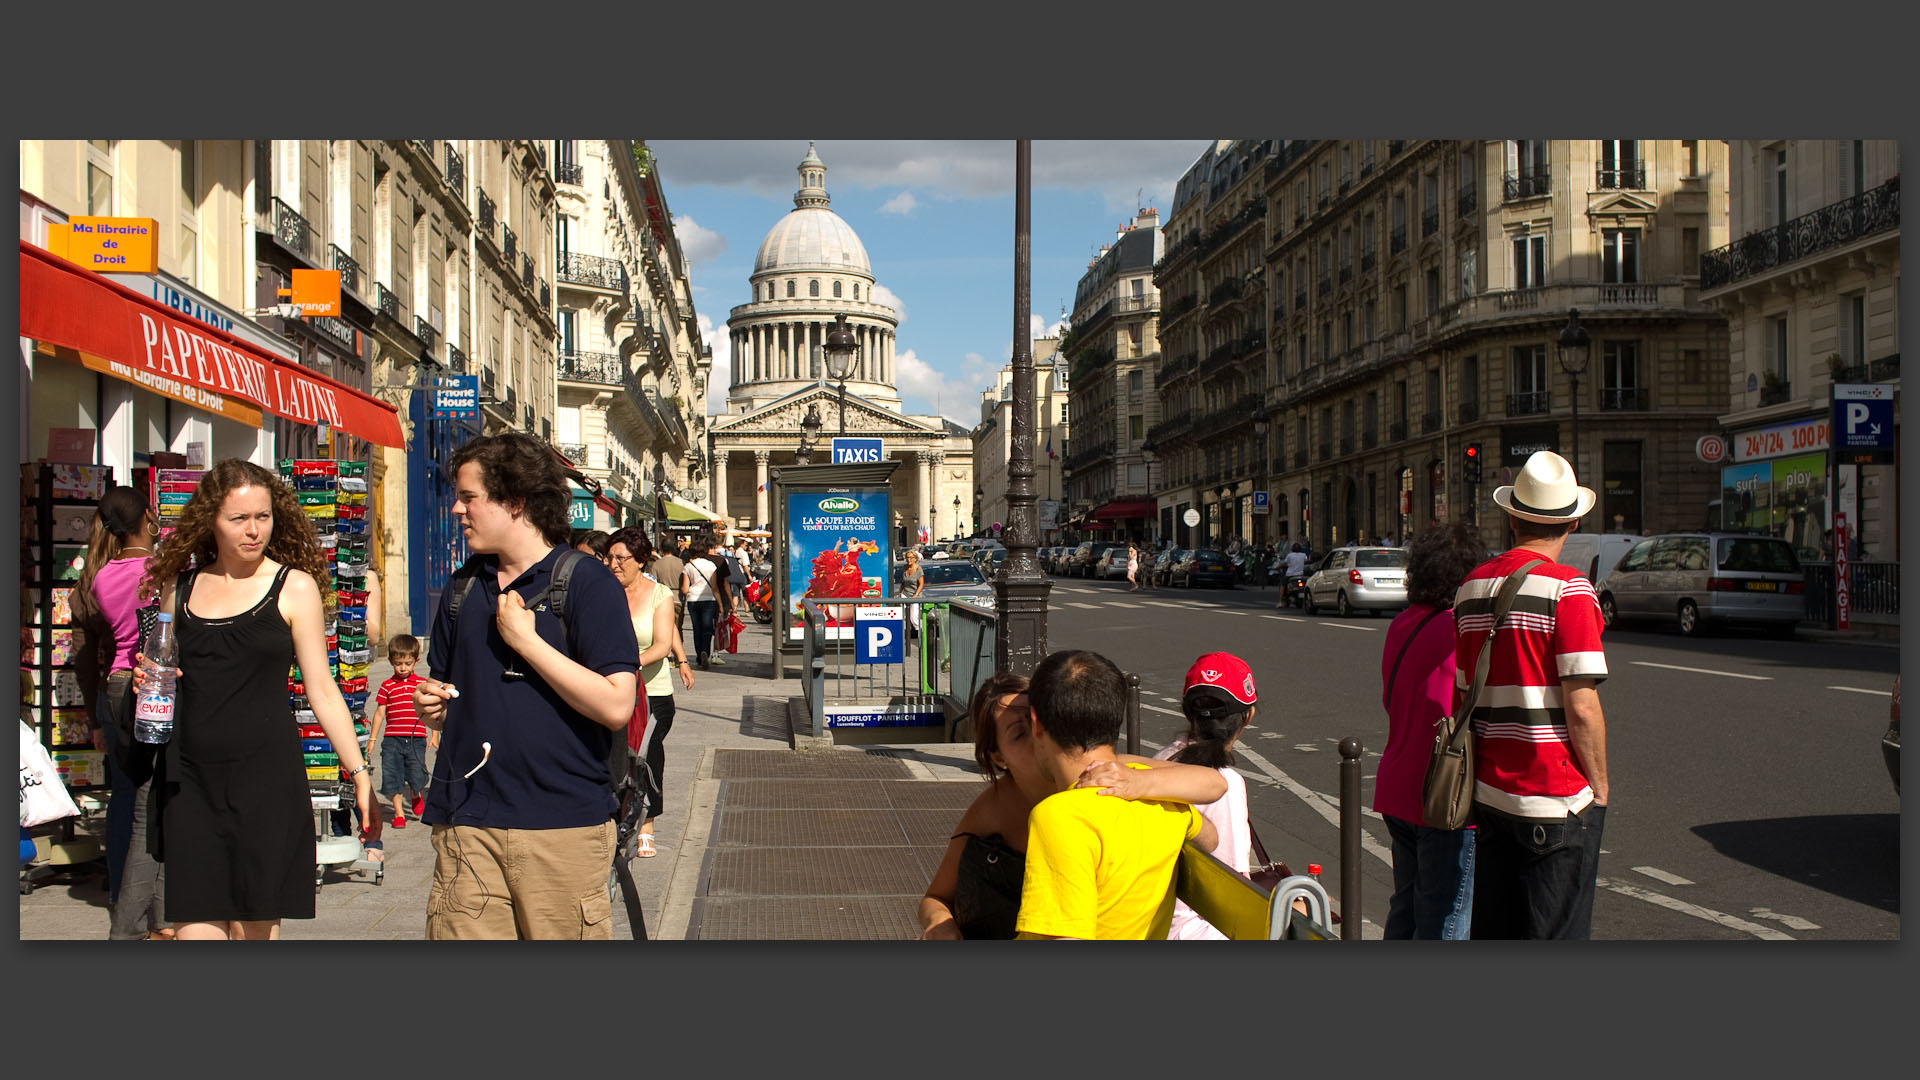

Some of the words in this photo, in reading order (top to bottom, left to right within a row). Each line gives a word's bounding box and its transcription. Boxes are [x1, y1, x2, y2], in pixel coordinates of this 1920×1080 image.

[73, 224, 93, 233] Ma
[97, 224, 148, 236] librairie
[102, 240, 119, 249] de
[93, 254, 127, 265] Droit
[294, 303, 332, 313] range
[139, 312, 271, 409] PAPETERIE
[273, 369, 344, 428] LATINE
[437, 398, 475, 408] House
[1847, 403, 1870, 434] P
[1792, 427, 1815, 449] 100
[837, 448, 881, 464] TAXIS
[1736, 473, 1759, 492] surf
[1786, 469, 1811, 490] play
[1257, 494, 1265, 504] P
[822, 502, 859, 510] Alvalle
[802, 517, 814, 525] LA
[815, 517, 843, 525] SOUPE
[845, 517, 876, 525] FROIDE
[1836, 533, 1848, 622] LAVAGE
[868, 627, 893, 658] P
[142, 703, 173, 714] evian
[837, 714, 872, 722] SOUFFLOT
